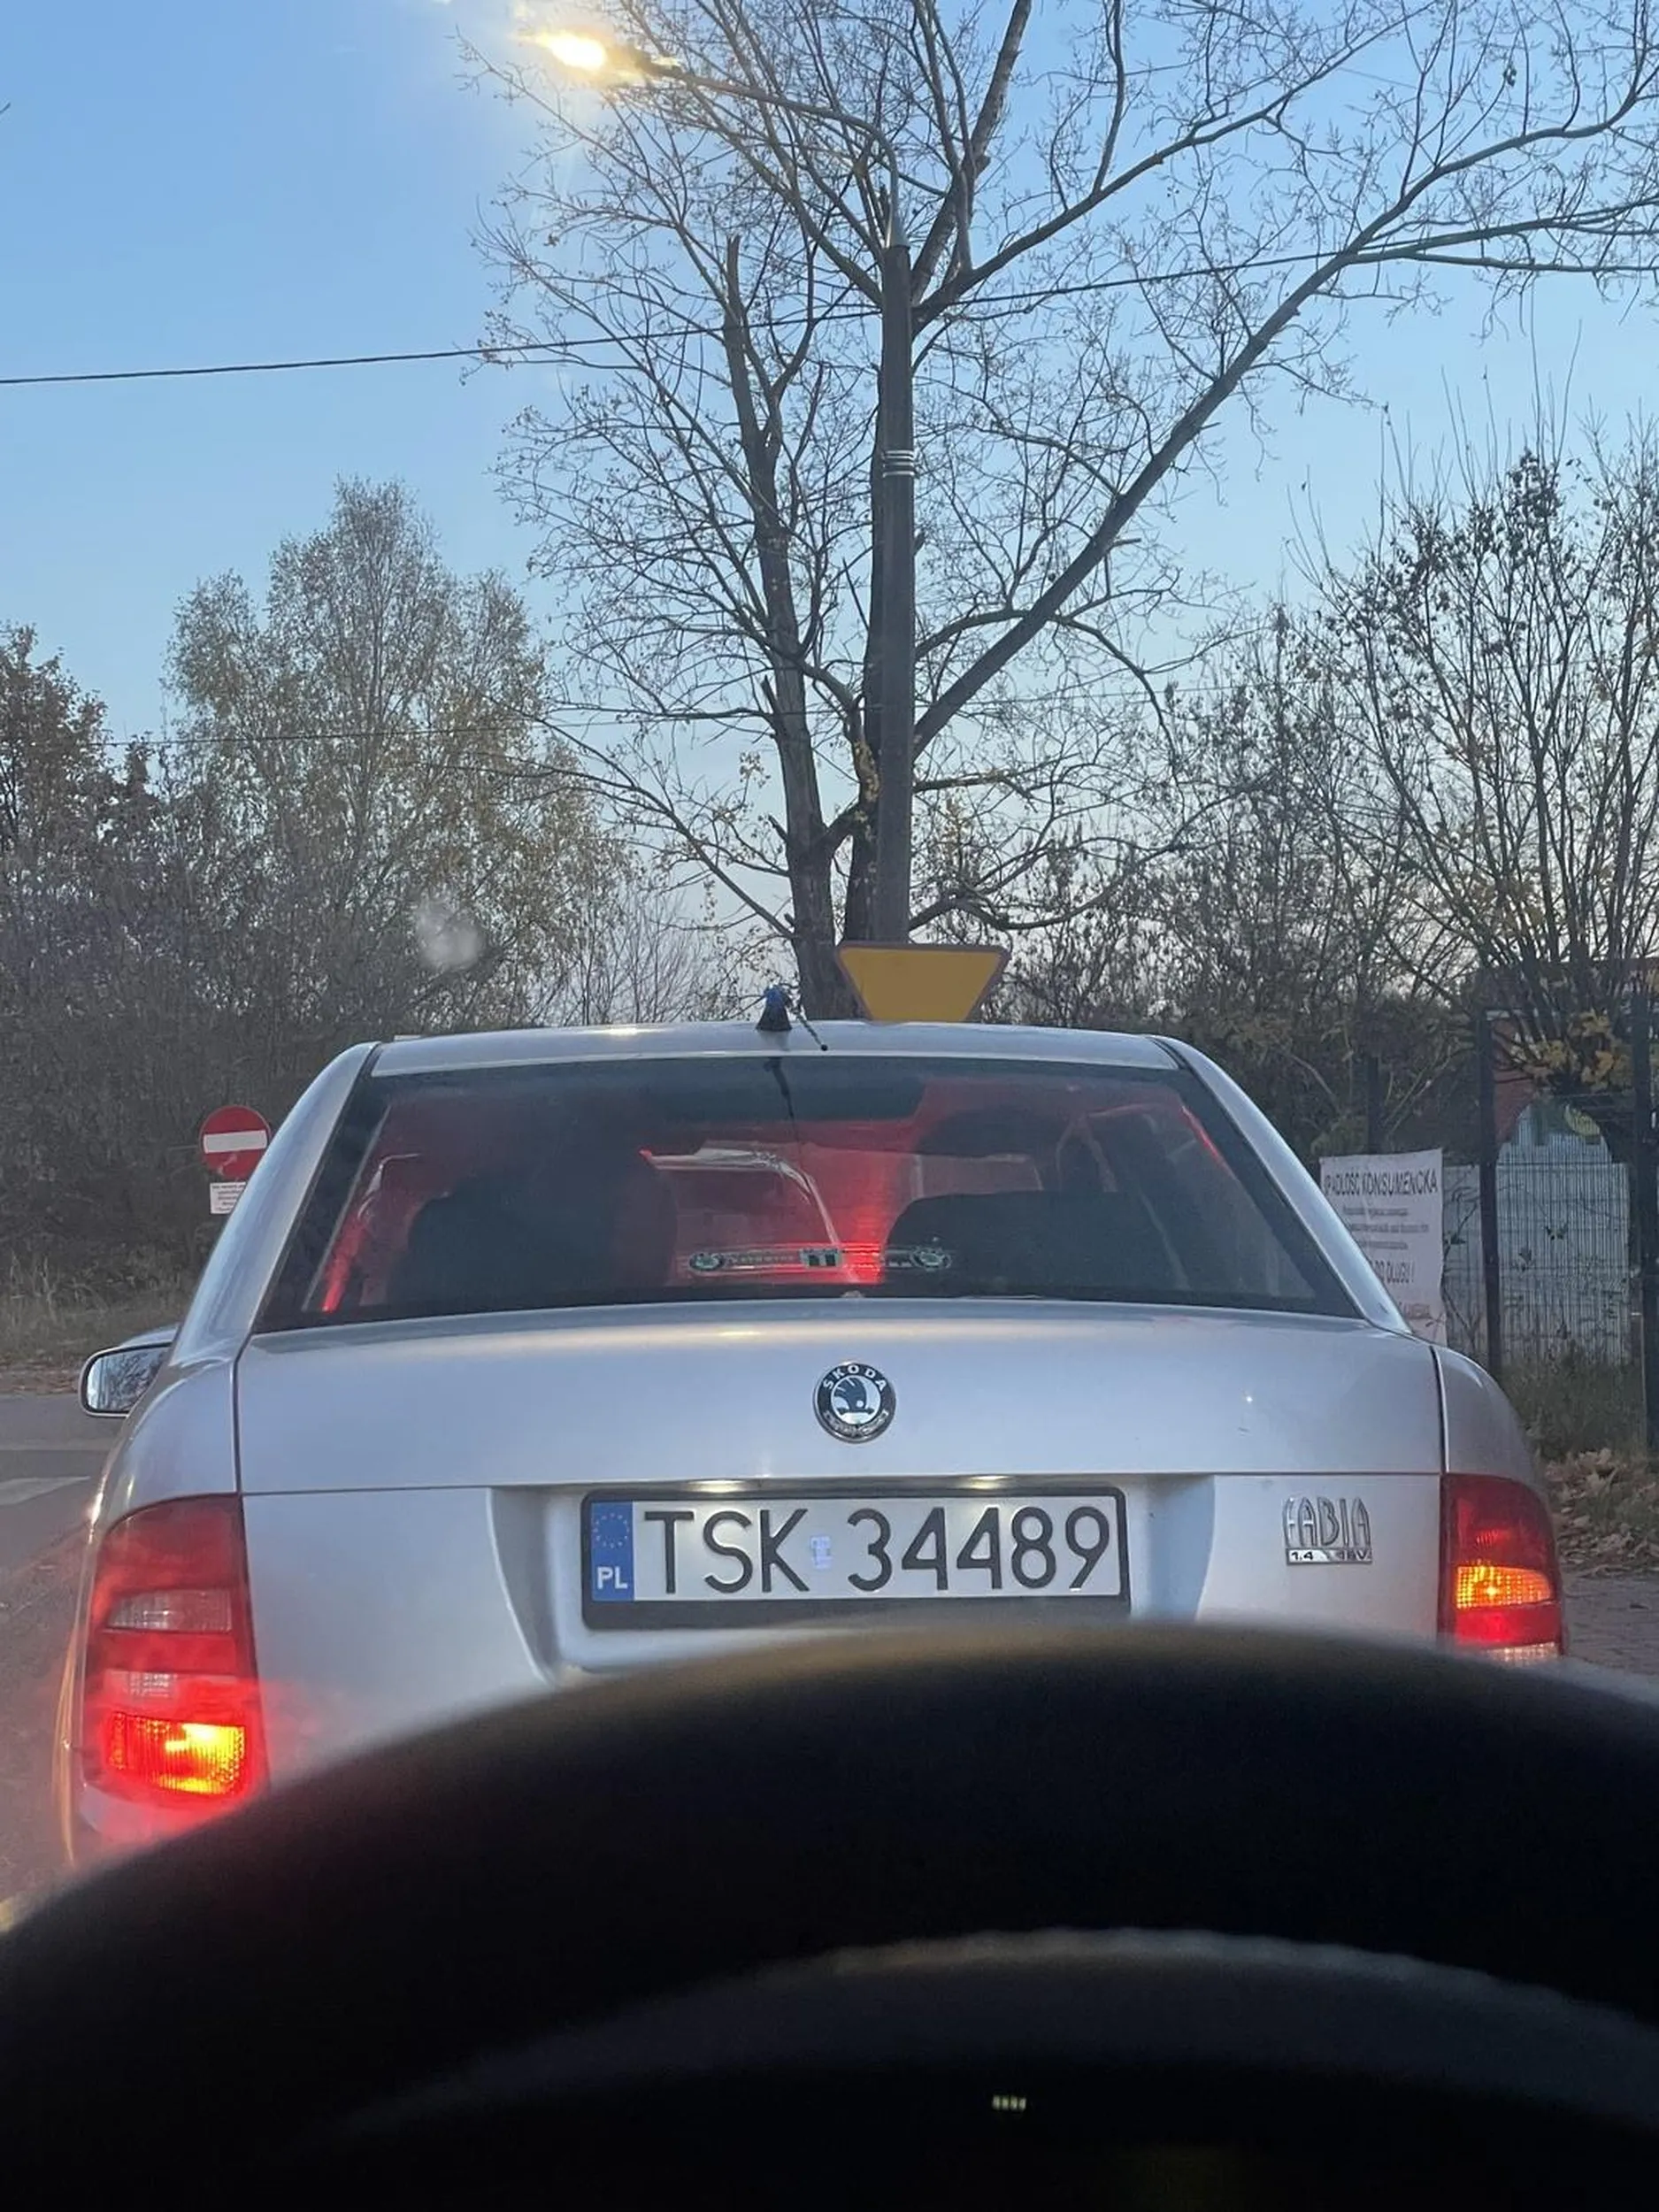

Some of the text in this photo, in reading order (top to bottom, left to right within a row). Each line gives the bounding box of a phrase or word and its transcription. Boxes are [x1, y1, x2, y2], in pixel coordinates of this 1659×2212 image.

[596, 1505, 1111, 1594] PL TSK 34489
[1281, 1496, 1371, 1547] FABIA
